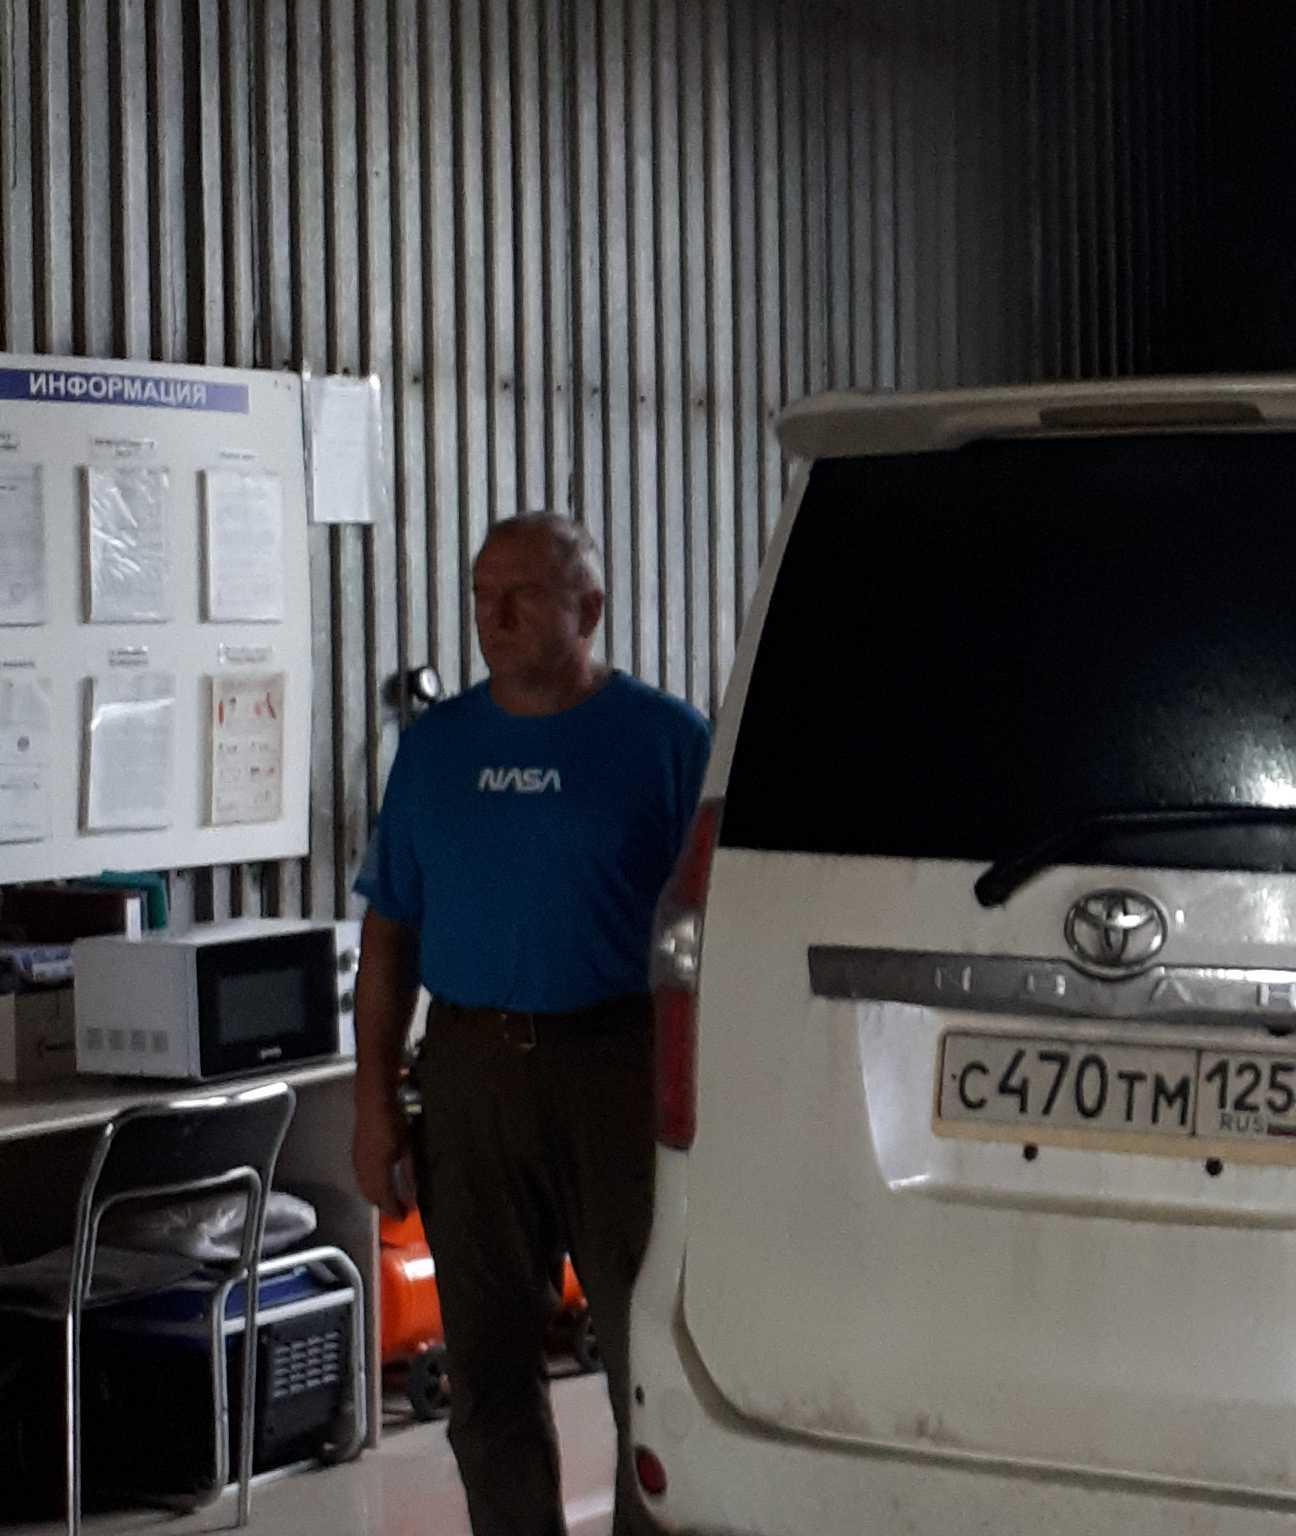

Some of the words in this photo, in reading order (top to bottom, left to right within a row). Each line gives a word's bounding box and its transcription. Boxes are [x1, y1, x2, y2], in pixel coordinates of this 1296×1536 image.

[29, 372, 208, 406] ИНФОРМАЦИЯ
[479, 767, 562, 793] NASA
[959, 1049, 1191, 1127] С470ТМ
[1205, 1059, 1296, 1115] 125
[1220, 1113, 1264, 1133] RUS
